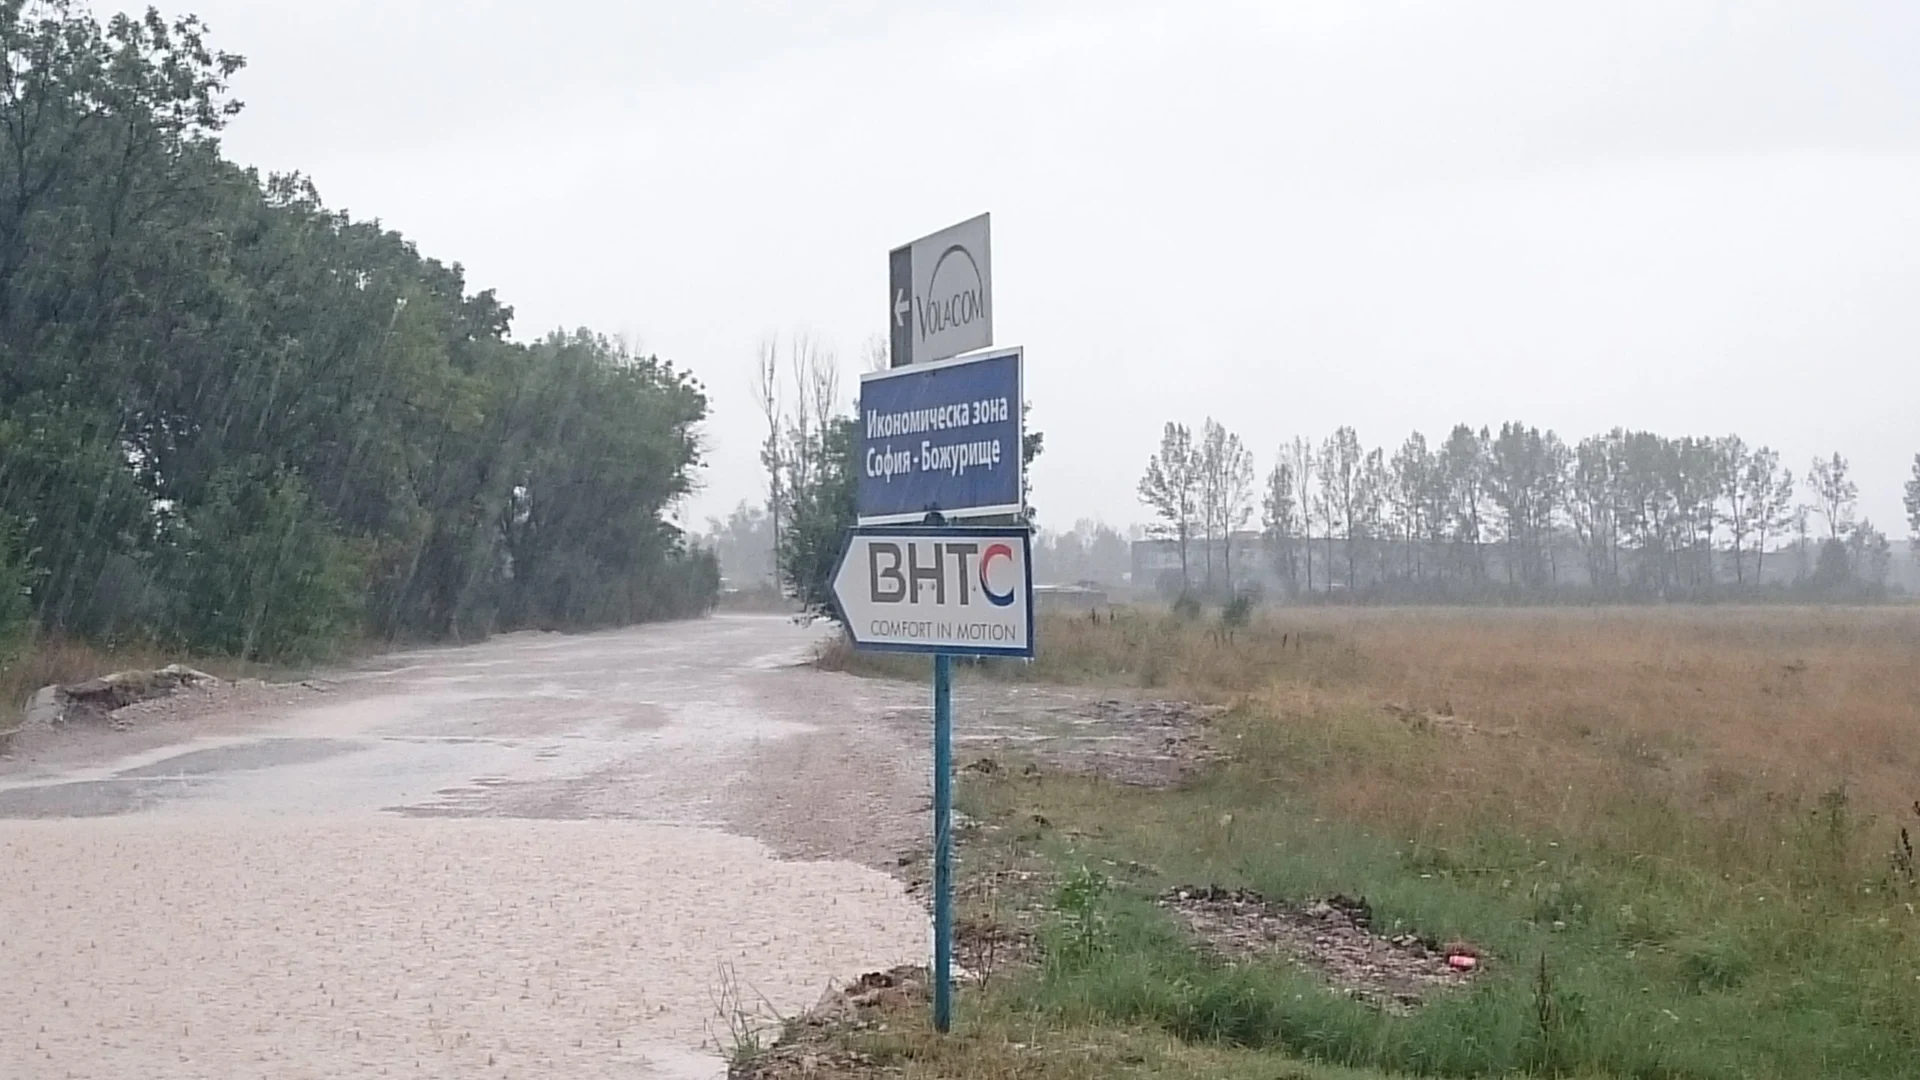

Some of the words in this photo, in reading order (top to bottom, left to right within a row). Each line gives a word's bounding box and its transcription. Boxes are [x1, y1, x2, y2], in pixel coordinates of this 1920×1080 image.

[916, 288, 984, 343] VOLACOM
[866, 402, 969, 439] Икономическа
[972, 397, 1008, 425] зона
[866, 444, 911, 483] София
[921, 439, 1000, 476] Божурище
[868, 542, 1015, 607] BHTC
[871, 620, 932, 638] COMFORT
[937, 623, 951, 639] IN
[957, 623, 1016, 641] MOTION
